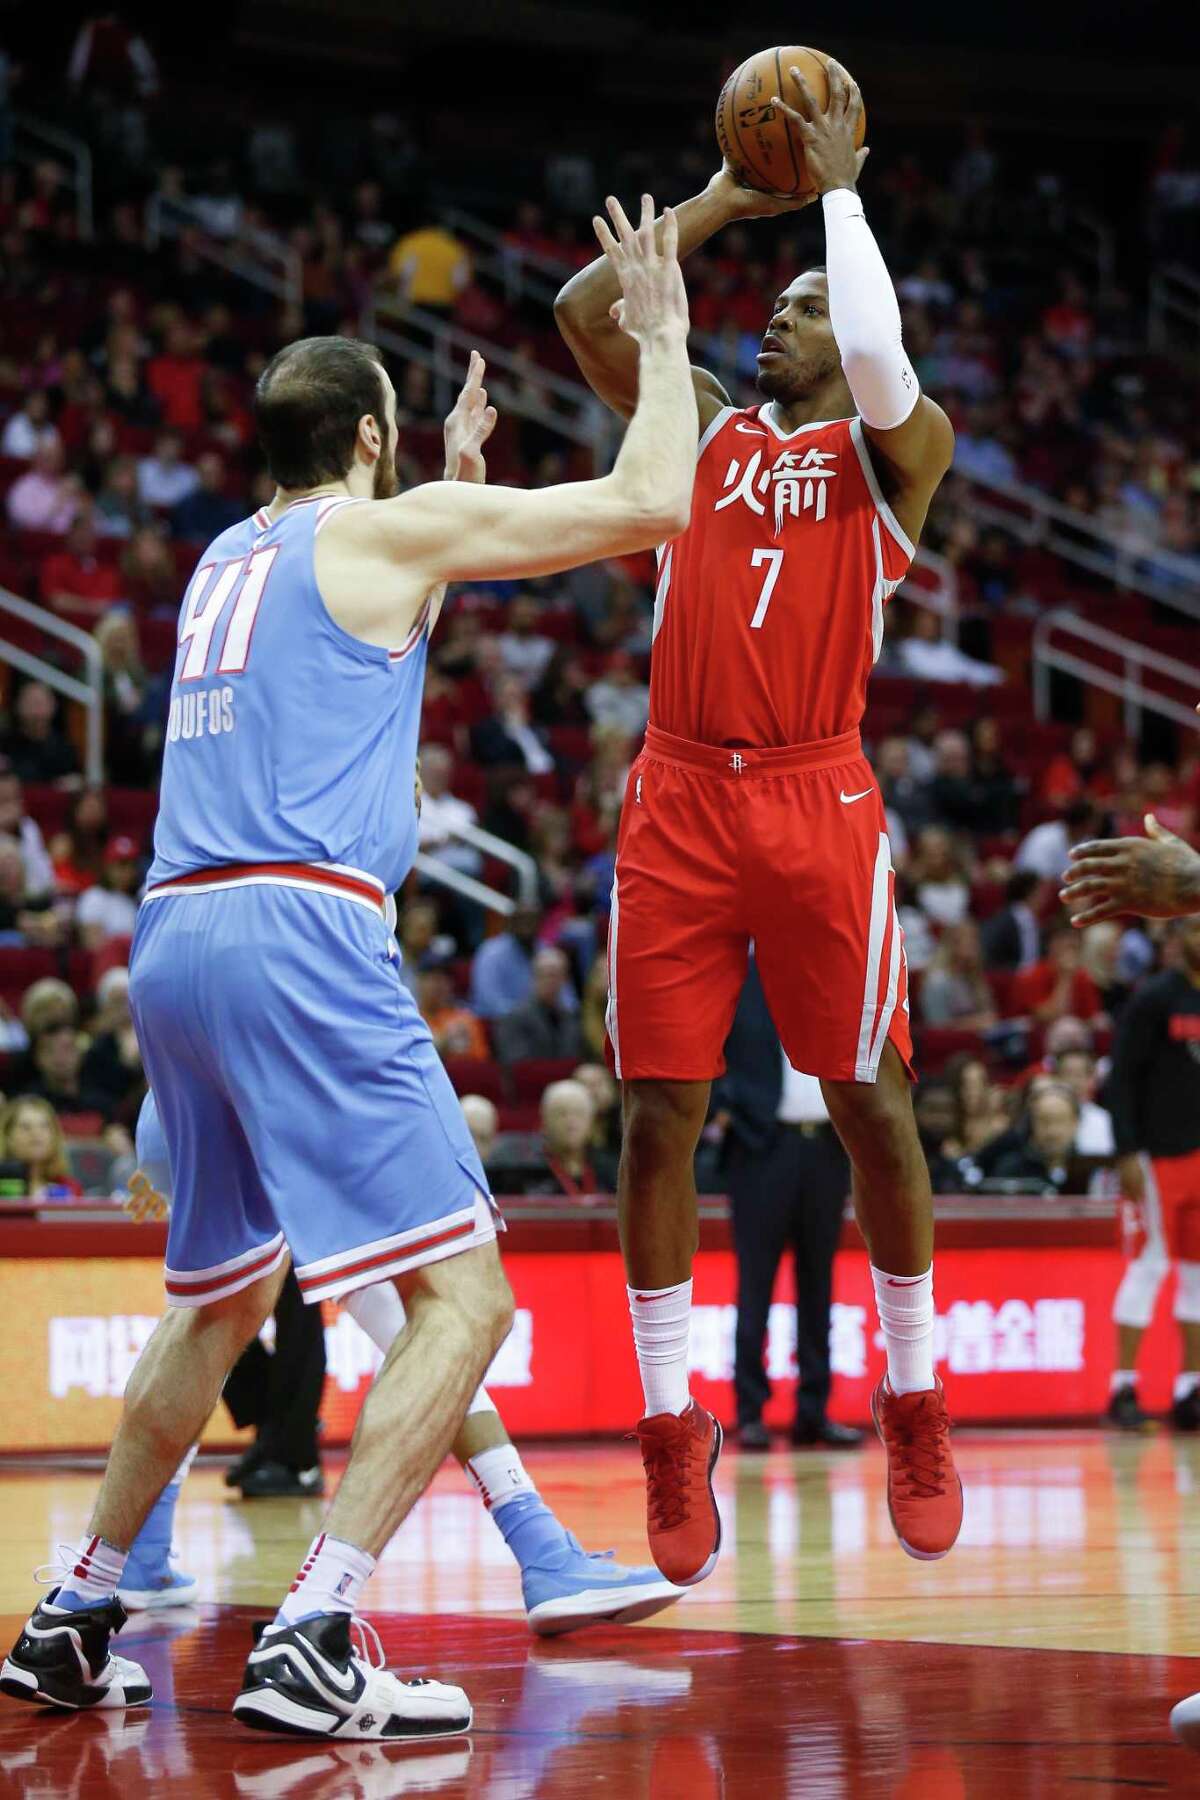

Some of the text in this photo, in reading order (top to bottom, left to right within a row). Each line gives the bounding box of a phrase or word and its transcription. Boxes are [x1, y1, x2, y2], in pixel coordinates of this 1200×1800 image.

[714, 448, 838, 539] 火箭
[178, 544, 281, 682] 41
[750, 547, 785, 629] 7
[169, 686, 235, 742] OUFOS
